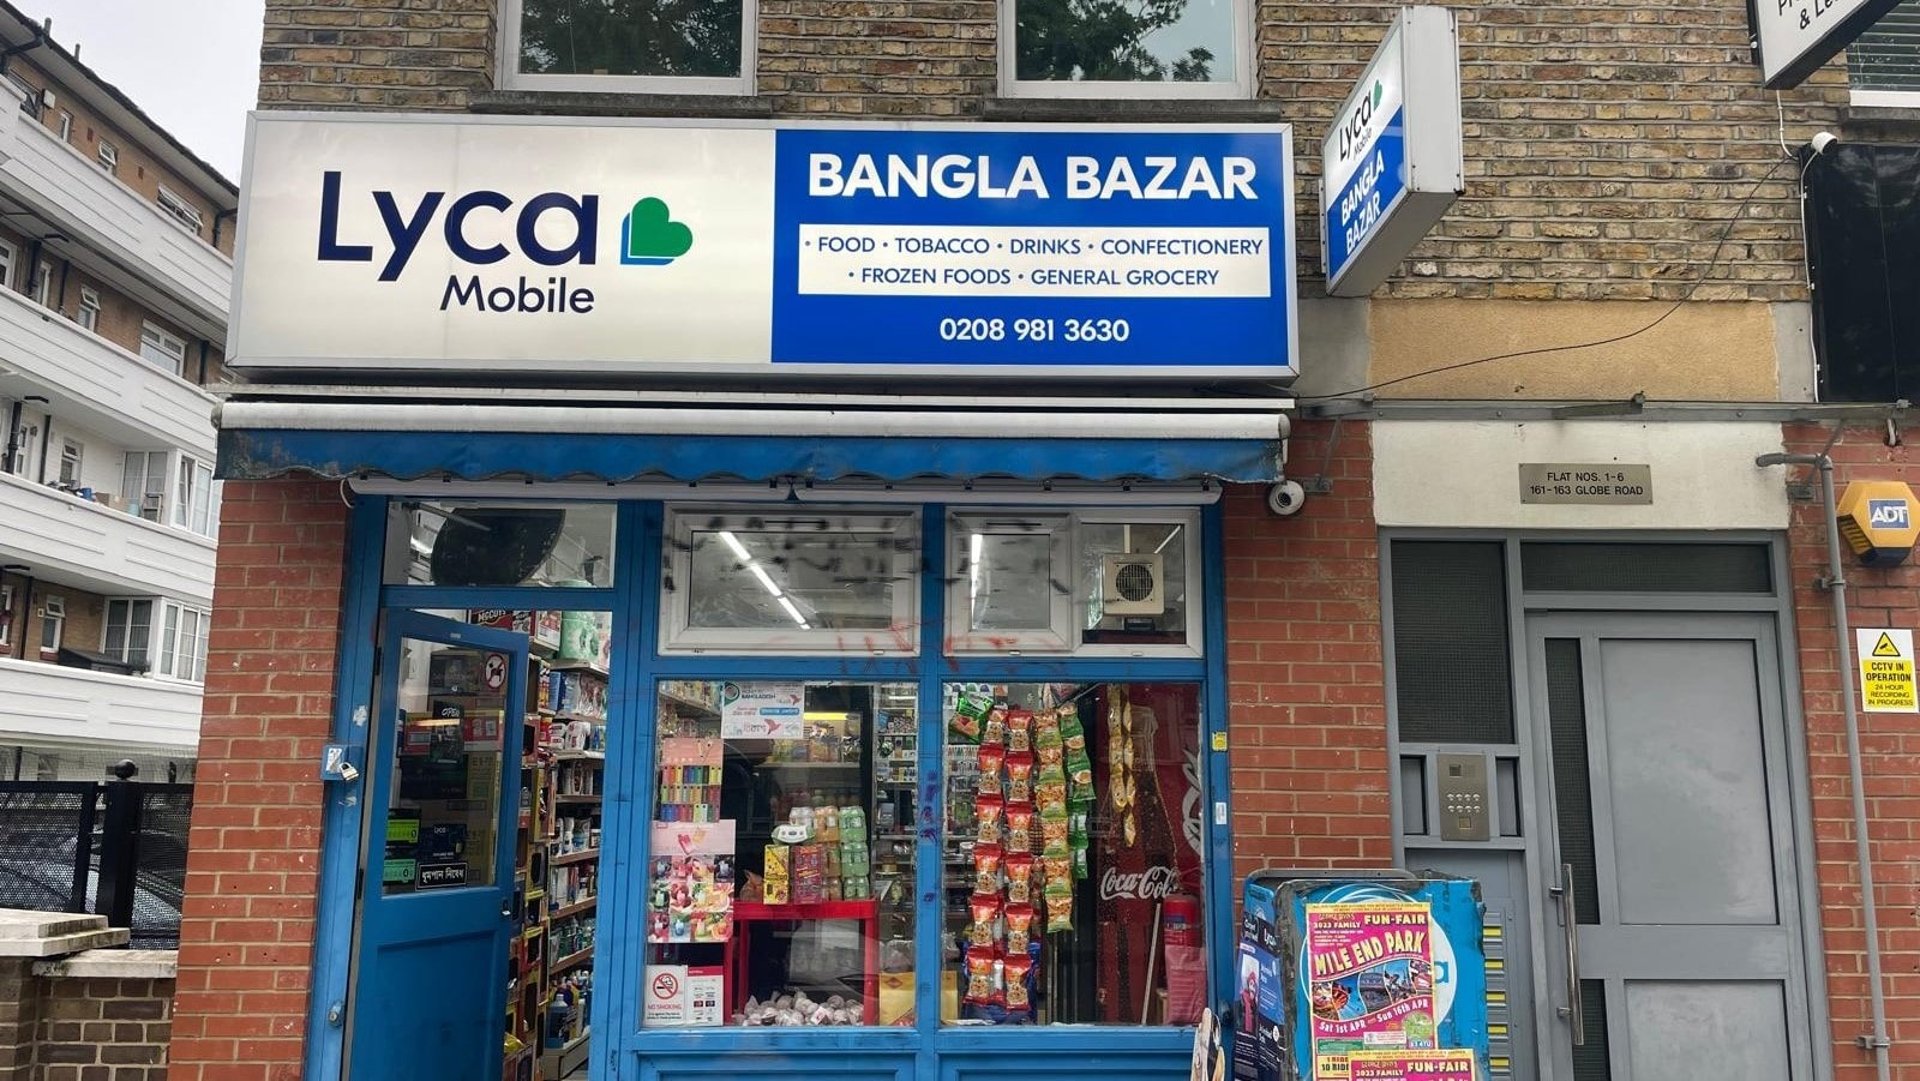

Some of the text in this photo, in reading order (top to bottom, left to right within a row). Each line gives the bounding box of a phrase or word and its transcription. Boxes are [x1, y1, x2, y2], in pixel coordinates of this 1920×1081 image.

[1800, 8, 1810, 30] &
[1339, 91, 1372, 162] Lyca
[808, 152, 1258, 200] BANGLA BAZAR
[1342, 149, 1384, 227] BANGLA
[317, 171, 599, 281] Lyca
[1346, 190, 1380, 256] BAZAR
[818, 237, 1263, 256] FOOD TOBACCO DRINKS CONFECTIONERY
[861, 268, 1220, 286] FROZEN FOODS GENERAL GROCERY
[440, 275, 595, 312] Mobile
[940, 318, 1130, 342] 0208 981 3630
[1547, 471, 1624, 482] FLAT NOS. 1-6
[1530, 486, 1644, 496] 161-163 GLOBE ROAD
[1872, 504, 1907, 523] ADT
[1866, 673, 1911, 682] OPERATION
[1872, 662, 1904, 671] CCTV IN
[1101, 866, 1176, 900] Coca-Col
[1364, 914, 1426, 924] FUN-FAIR
[1314, 948, 1353, 976] MILE
[1351, 936, 1384, 965] END
[1384, 930, 1425, 954] PARK
[1319, 1021, 1333, 1033] Sat
[1336, 1023, 1348, 1034] 1st
[1350, 1020, 1366, 1032] APR
[1376, 1010, 1392, 1022] Sun
[1412, 999, 1428, 1010] APR
[1408, 1062, 1468, 1072] FUN-FAIR
